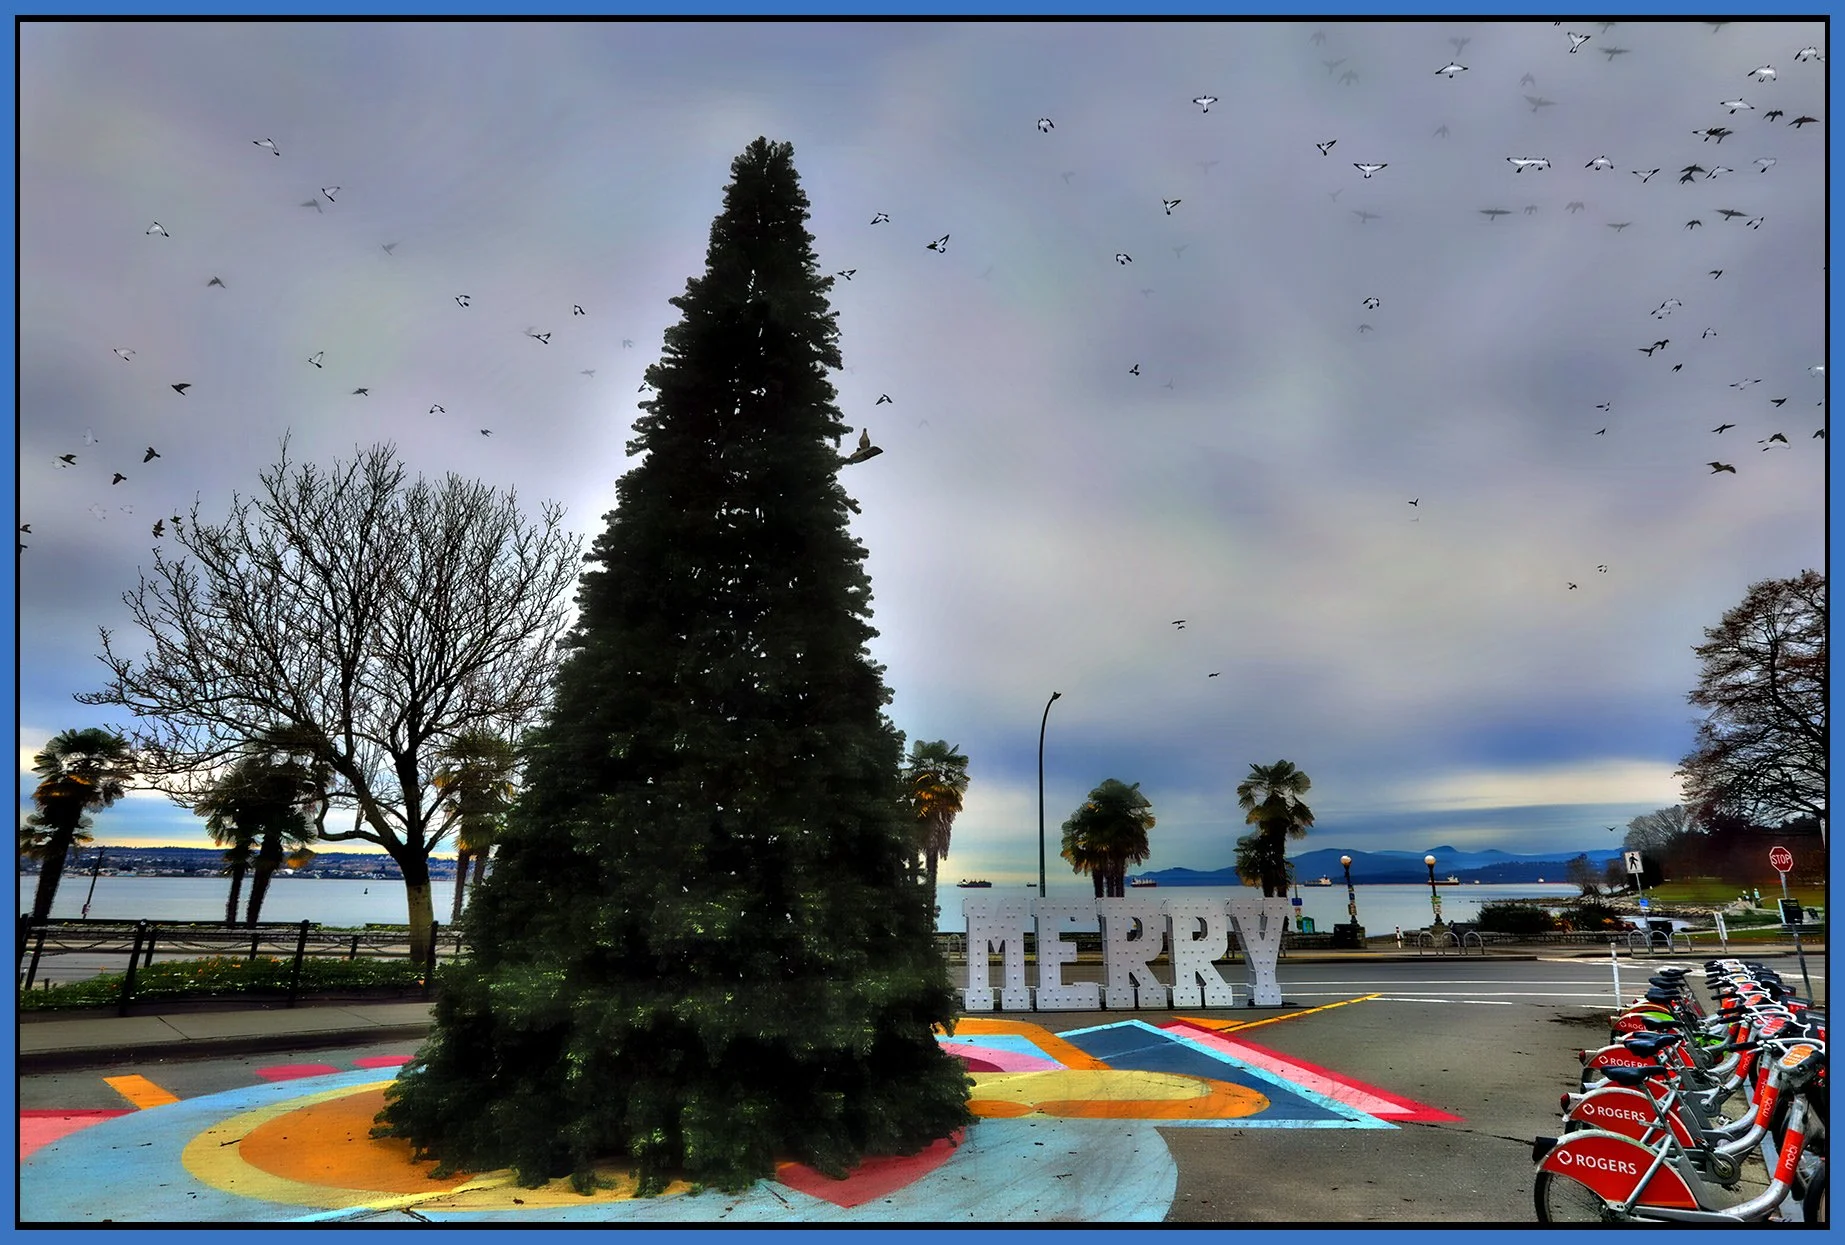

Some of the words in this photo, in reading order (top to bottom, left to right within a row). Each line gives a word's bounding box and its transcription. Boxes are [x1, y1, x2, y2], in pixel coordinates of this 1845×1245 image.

[1771, 854, 1791, 865] STOP
[962, 897, 1288, 1010] MERRY
[1628, 1022, 1647, 1031] ROG
[1597, 1106, 1646, 1121] ROGERS
[1762, 1097, 1773, 1118] mobi
[1575, 1153, 1637, 1175] ROGERS
[1784, 1144, 1798, 1171] mobi
